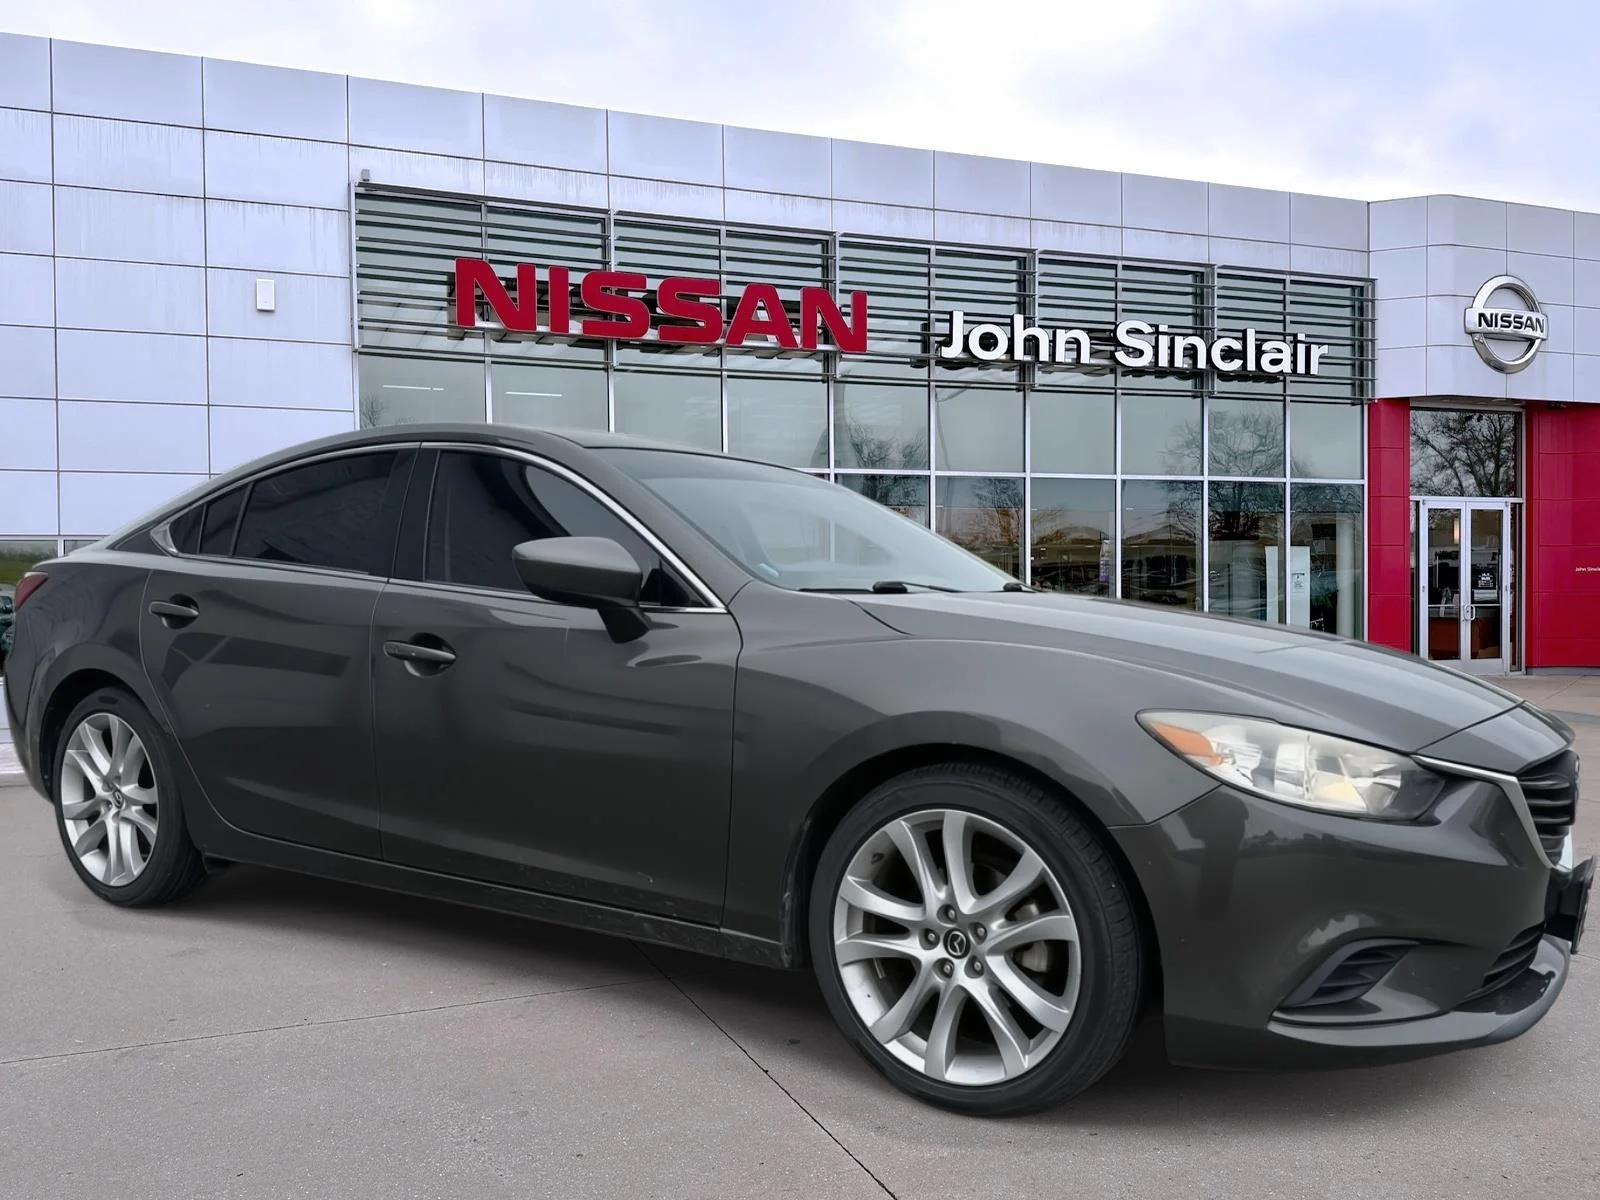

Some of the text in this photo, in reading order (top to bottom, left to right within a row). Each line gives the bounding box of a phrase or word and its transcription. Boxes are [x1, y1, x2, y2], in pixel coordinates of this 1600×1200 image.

[455, 257, 868, 353] NISSAN
[1478, 312, 1545, 333] NISSAN
[940, 310, 1329, 375] John Sinclair
